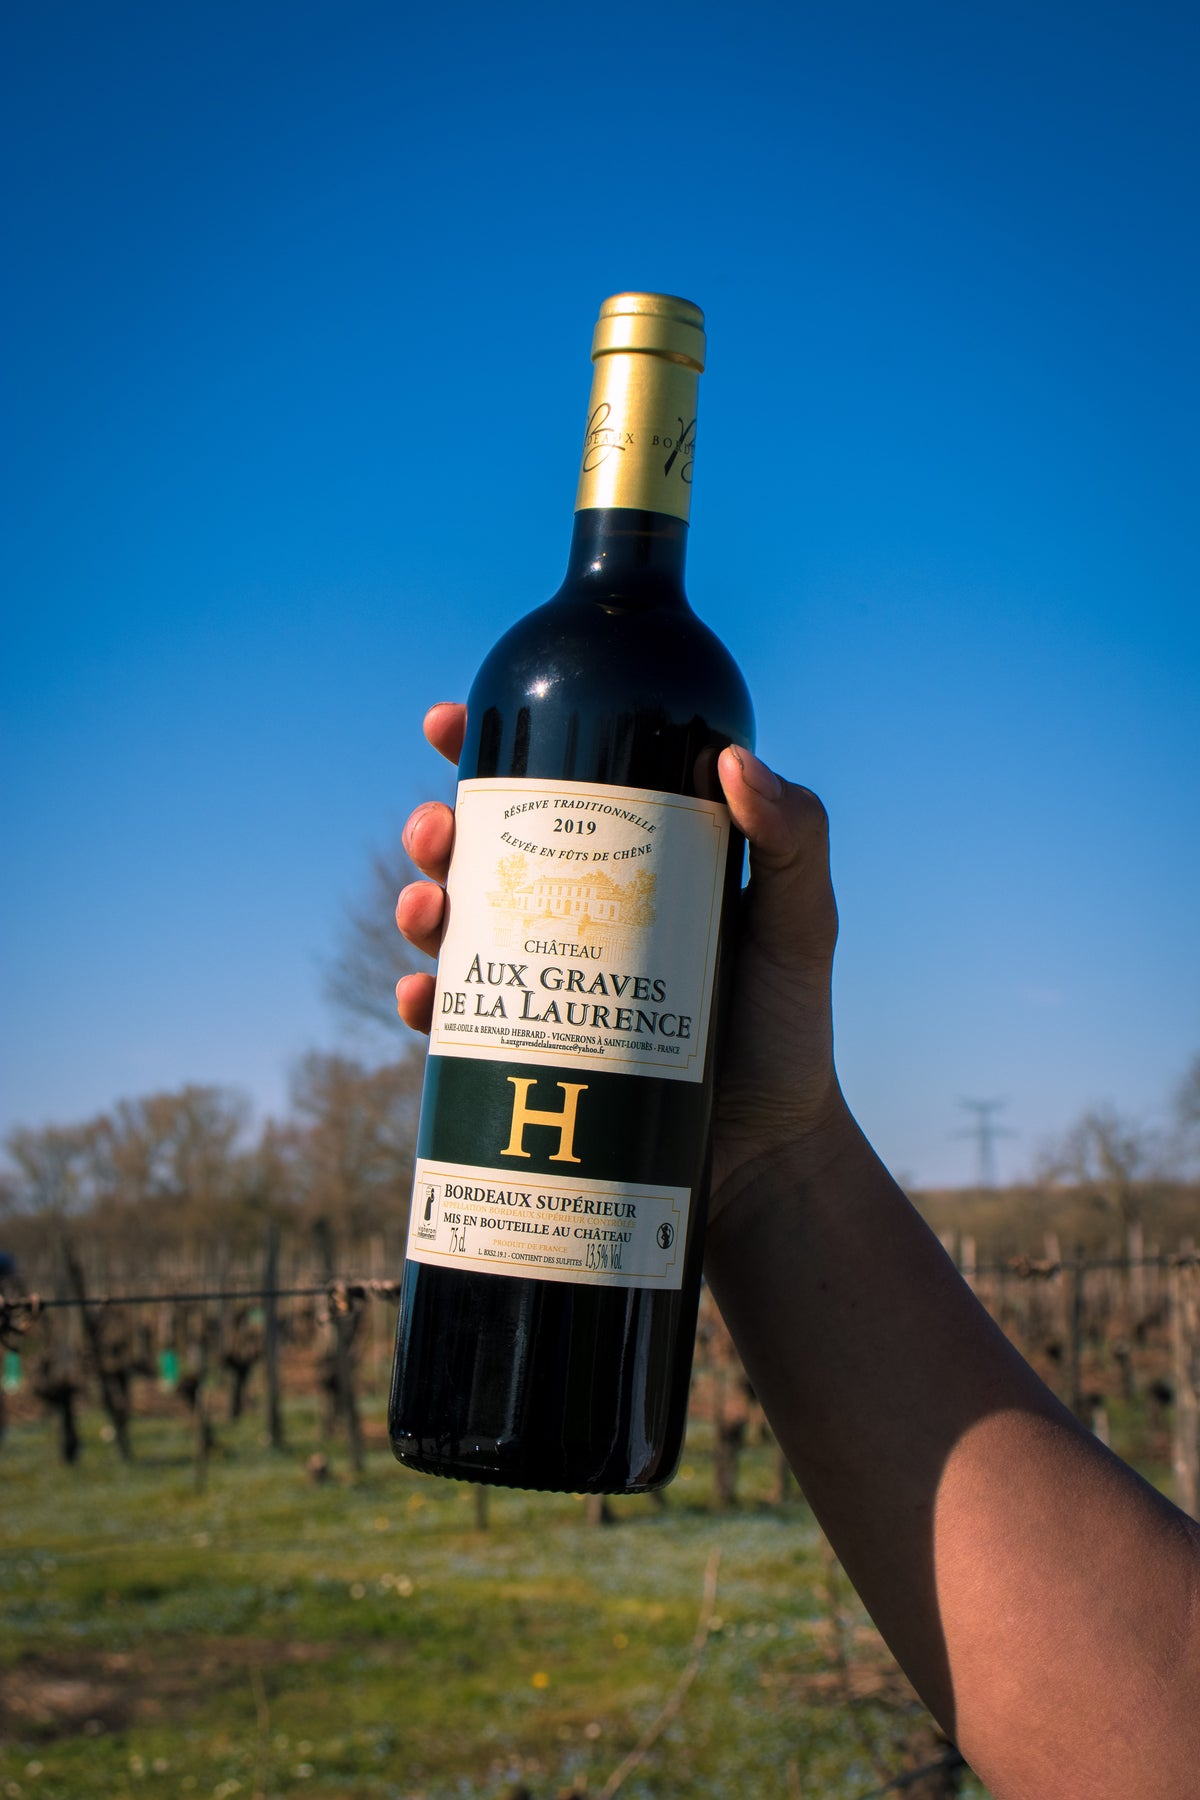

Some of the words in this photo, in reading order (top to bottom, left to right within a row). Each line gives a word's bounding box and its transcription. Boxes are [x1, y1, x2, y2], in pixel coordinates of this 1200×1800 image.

[504, 799, 549, 819] RÉSERVE
[553, 799, 657, 834] TRADITIONNELLE
[553, 818, 596, 835] 2019
[500, 832, 538, 854] ÉLEVÉE
[540, 847, 556, 858] EN
[558, 850, 588, 861] FÛTS
[593, 852, 609, 861] DE
[613, 843, 652, 860] CHÊNE
[524, 939, 603, 959] CHÂTEAU
[464, 953, 528, 987] AUX
[540, 966, 666, 1003] GRAVES
[441, 991, 466, 1015] DE
[474, 993, 508, 1018] LA
[520, 990, 692, 1039] LAURENCE
[480, 1025, 510, 1036] BERNARD
[512, 1029, 546, 1039] HEBRARD
[552, 1032, 596, 1045] VIGNERONS
[604, 1038, 653, 1051] SAINT-LOUBÈS
[657, 1044, 680, 1055] FRANCE
[500, 1076, 589, 1163] H
[444, 1184, 532, 1208] BORDEAUX
[536, 1195, 637, 1218] SUPÉRIEUR
[489, 1206, 534, 1219] BORDEAUX
[443, 1212, 461, 1224] MIS
[463, 1215, 477, 1226] EN
[480, 1217, 550, 1235] BOUTEILLE
[552, 1226, 570, 1237] AU
[574, 1227, 632, 1242] CHÂTEAU
[449, 1227, 458, 1253] 75
[492, 1239, 525, 1250] PRODUIT
[527, 1242, 538, 1250] DE
[540, 1244, 568, 1253] FRANCE
[511, 1252, 542, 1263] CONTIENT
[543, 1256, 555, 1264] DES
[556, 1257, 582, 1267] SULFITES
[585, 1243, 608, 1271] 13,5%
